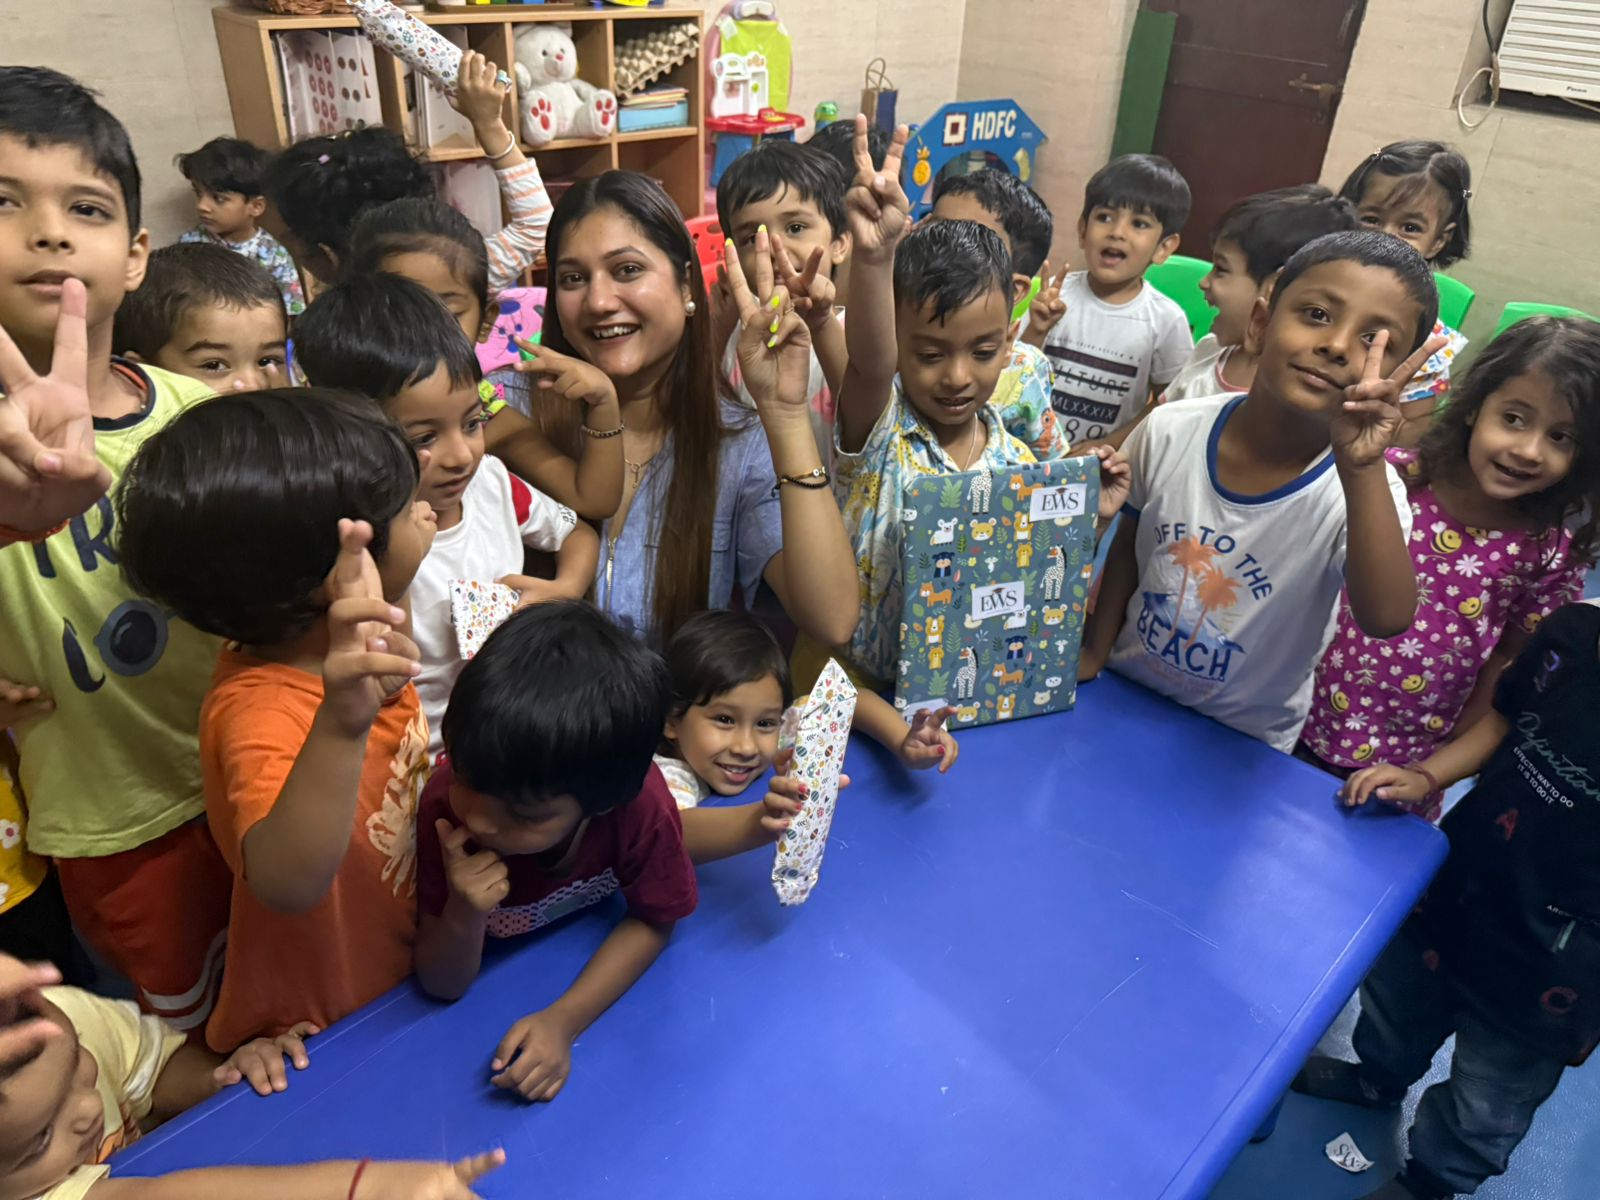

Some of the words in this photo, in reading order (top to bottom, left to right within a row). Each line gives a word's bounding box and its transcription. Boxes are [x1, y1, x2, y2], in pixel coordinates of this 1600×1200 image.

[972, 110, 1017, 141] HDFC
[1053, 362, 1130, 398] ULTURE
[1040, 492, 1079, 512] EWS
[1199, 525, 1236, 553] TO
[1235, 553, 1273, 600] THE
[979, 590, 1017, 612] EWS
[1137, 604, 1232, 677] BEACH
[1528, 776, 1538, 789] TO
[1536, 786, 1547, 800] DO
[1544, 794, 1555, 805] IT
[1536, 770, 1551, 790] WAY
[1548, 784, 1560, 799] TO
[1559, 795, 1574, 808] DO
